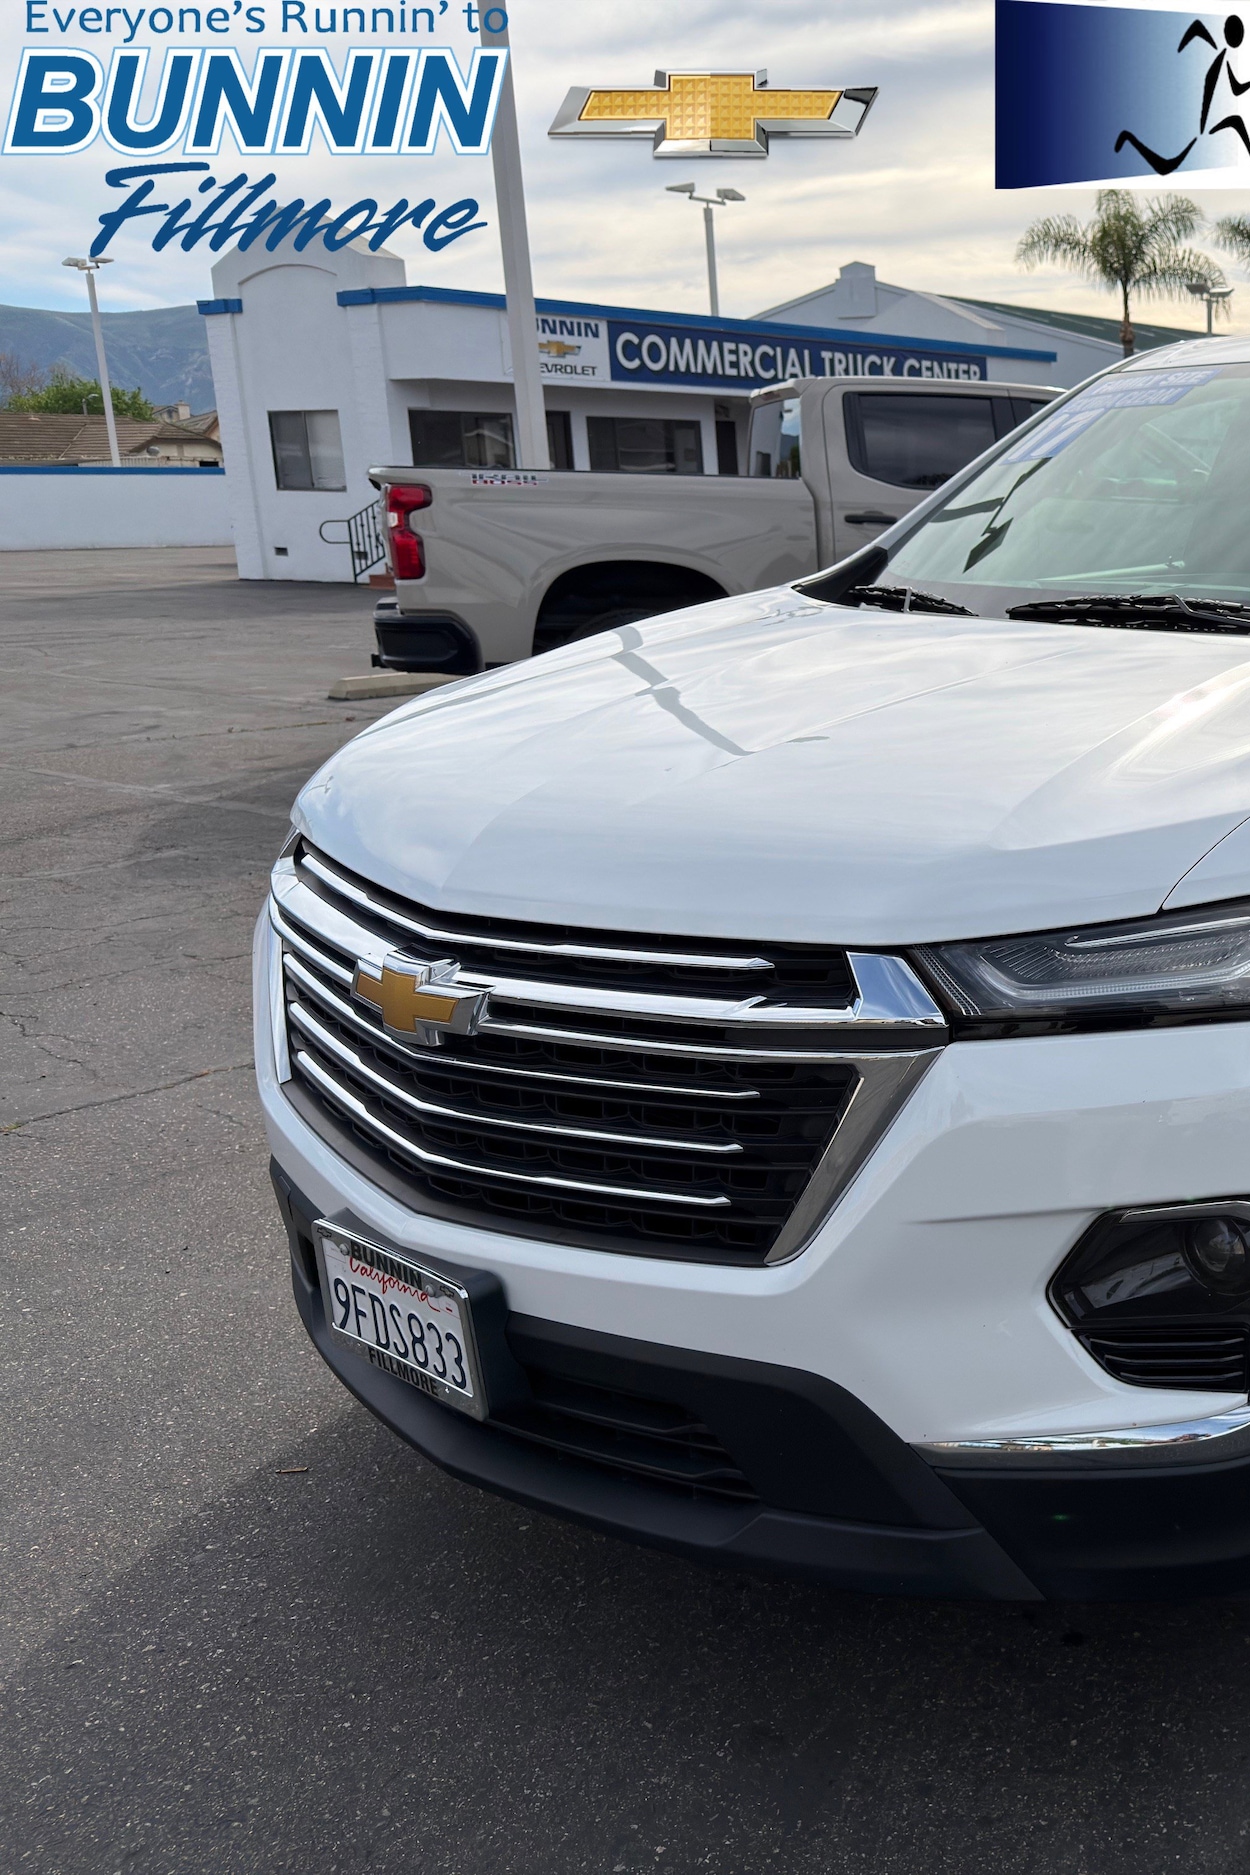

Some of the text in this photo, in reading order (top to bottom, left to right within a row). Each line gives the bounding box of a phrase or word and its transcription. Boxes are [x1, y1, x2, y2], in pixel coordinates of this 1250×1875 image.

[536, 318, 600, 339] NNIN
[540, 362, 598, 377] EVROLET
[615, 331, 815, 379] COMMERCIAL
[821, 350, 896, 377] TRUCK
[350, 1241, 423, 1289] BUNNIN
[333, 1277, 468, 1390] 9FDS833
[368, 1346, 439, 1397] FILLMORE
